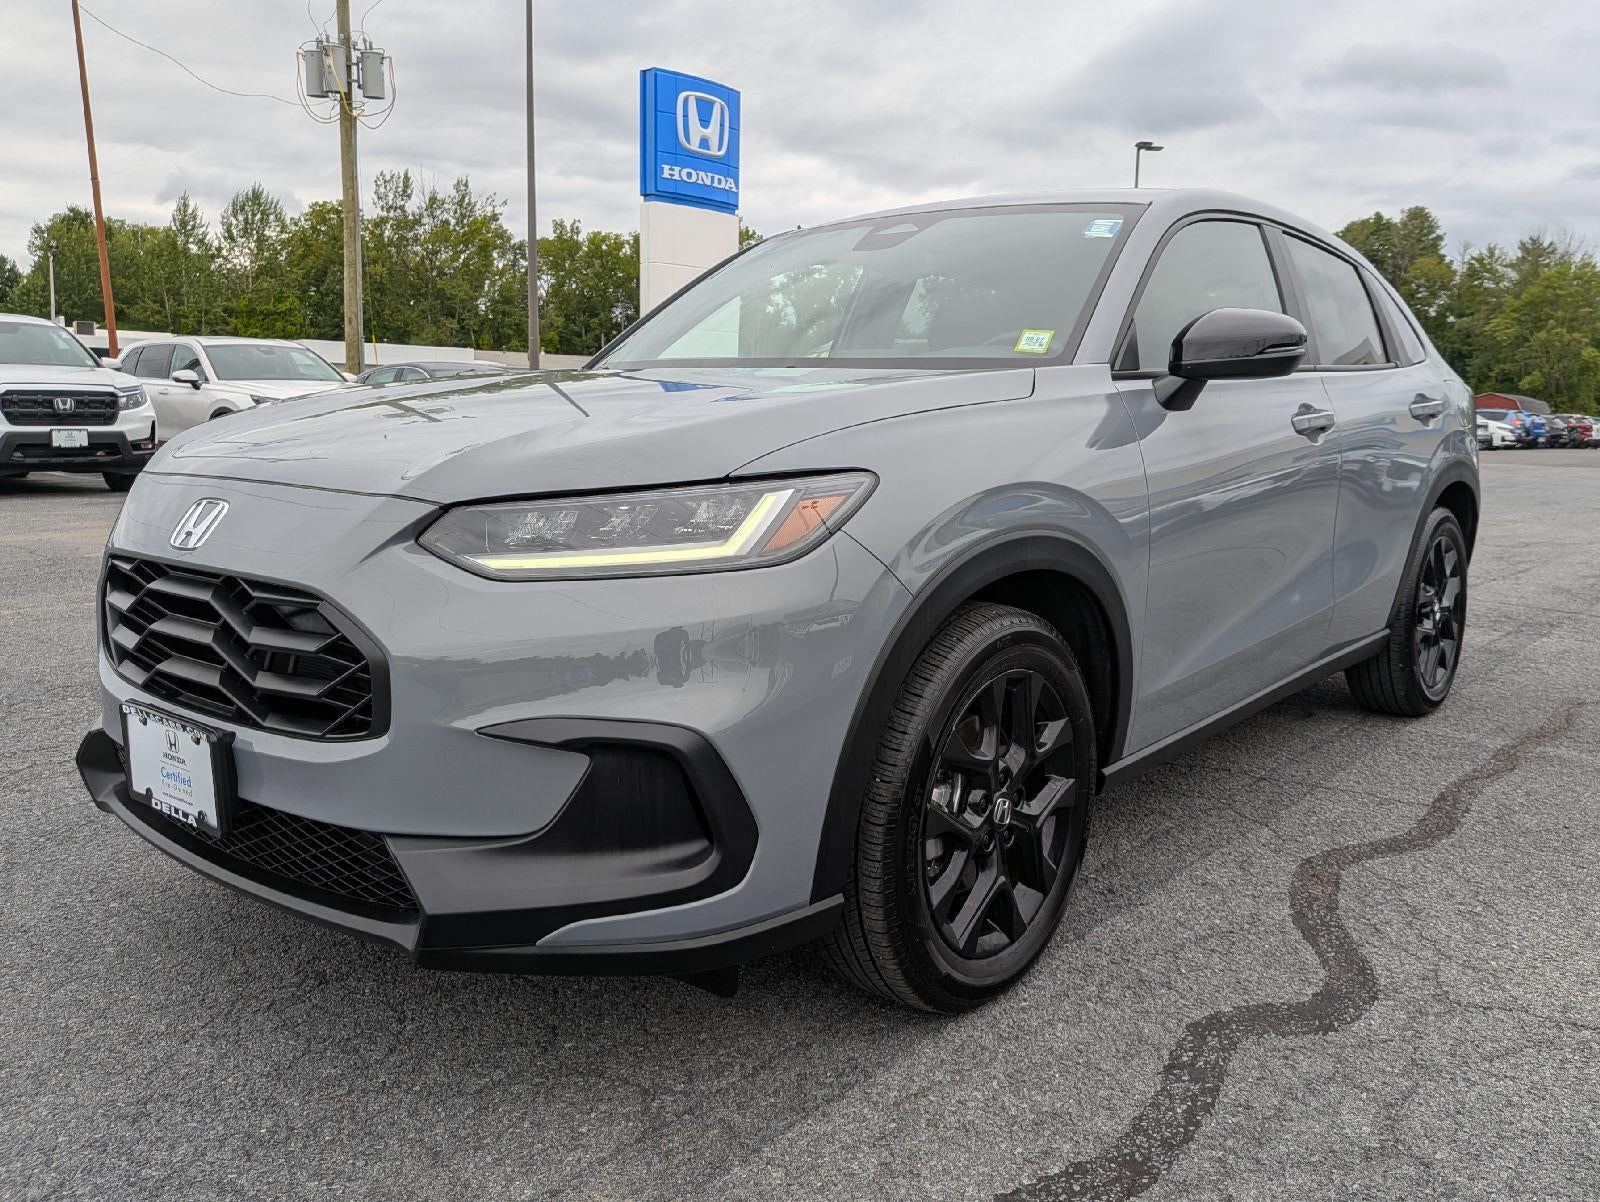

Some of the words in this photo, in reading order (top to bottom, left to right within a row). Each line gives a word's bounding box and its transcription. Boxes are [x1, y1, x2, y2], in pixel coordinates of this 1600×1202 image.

[661, 164, 738, 192] HONDA
[160, 766, 192, 788] Certified
[151, 797, 198, 828] DELLA
